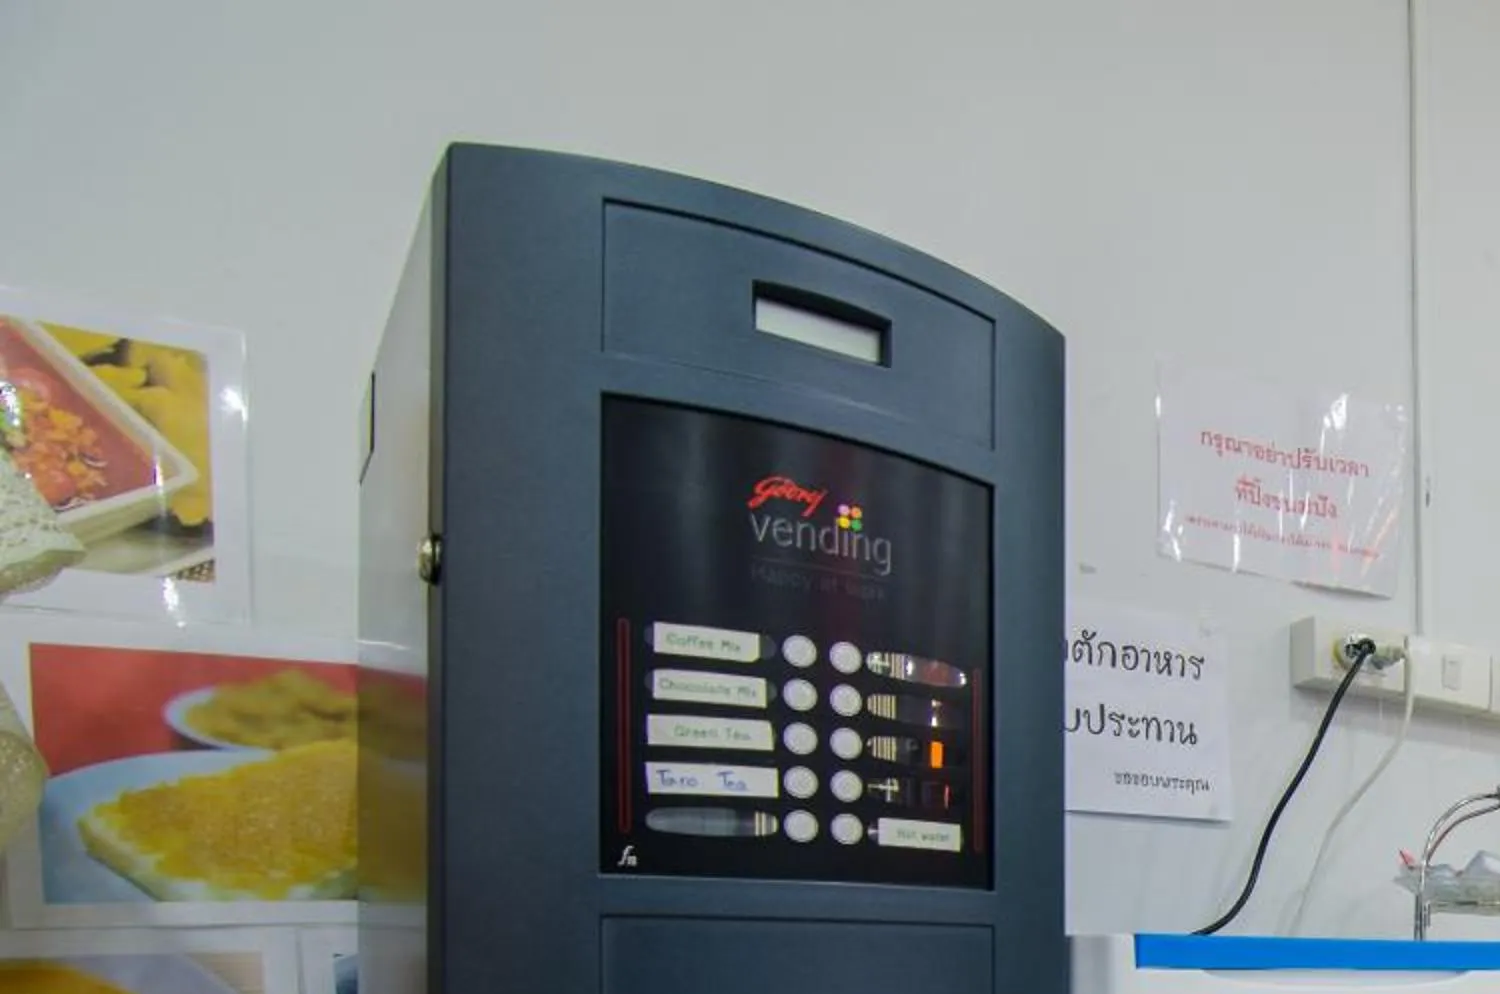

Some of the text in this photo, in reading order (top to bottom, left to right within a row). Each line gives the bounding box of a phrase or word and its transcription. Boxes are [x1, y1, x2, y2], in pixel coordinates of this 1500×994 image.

[750, 513, 892, 576] vending
[1063, 629, 1205, 680] ตักอาหาร
[656, 769, 749, 792] Taro Tea
